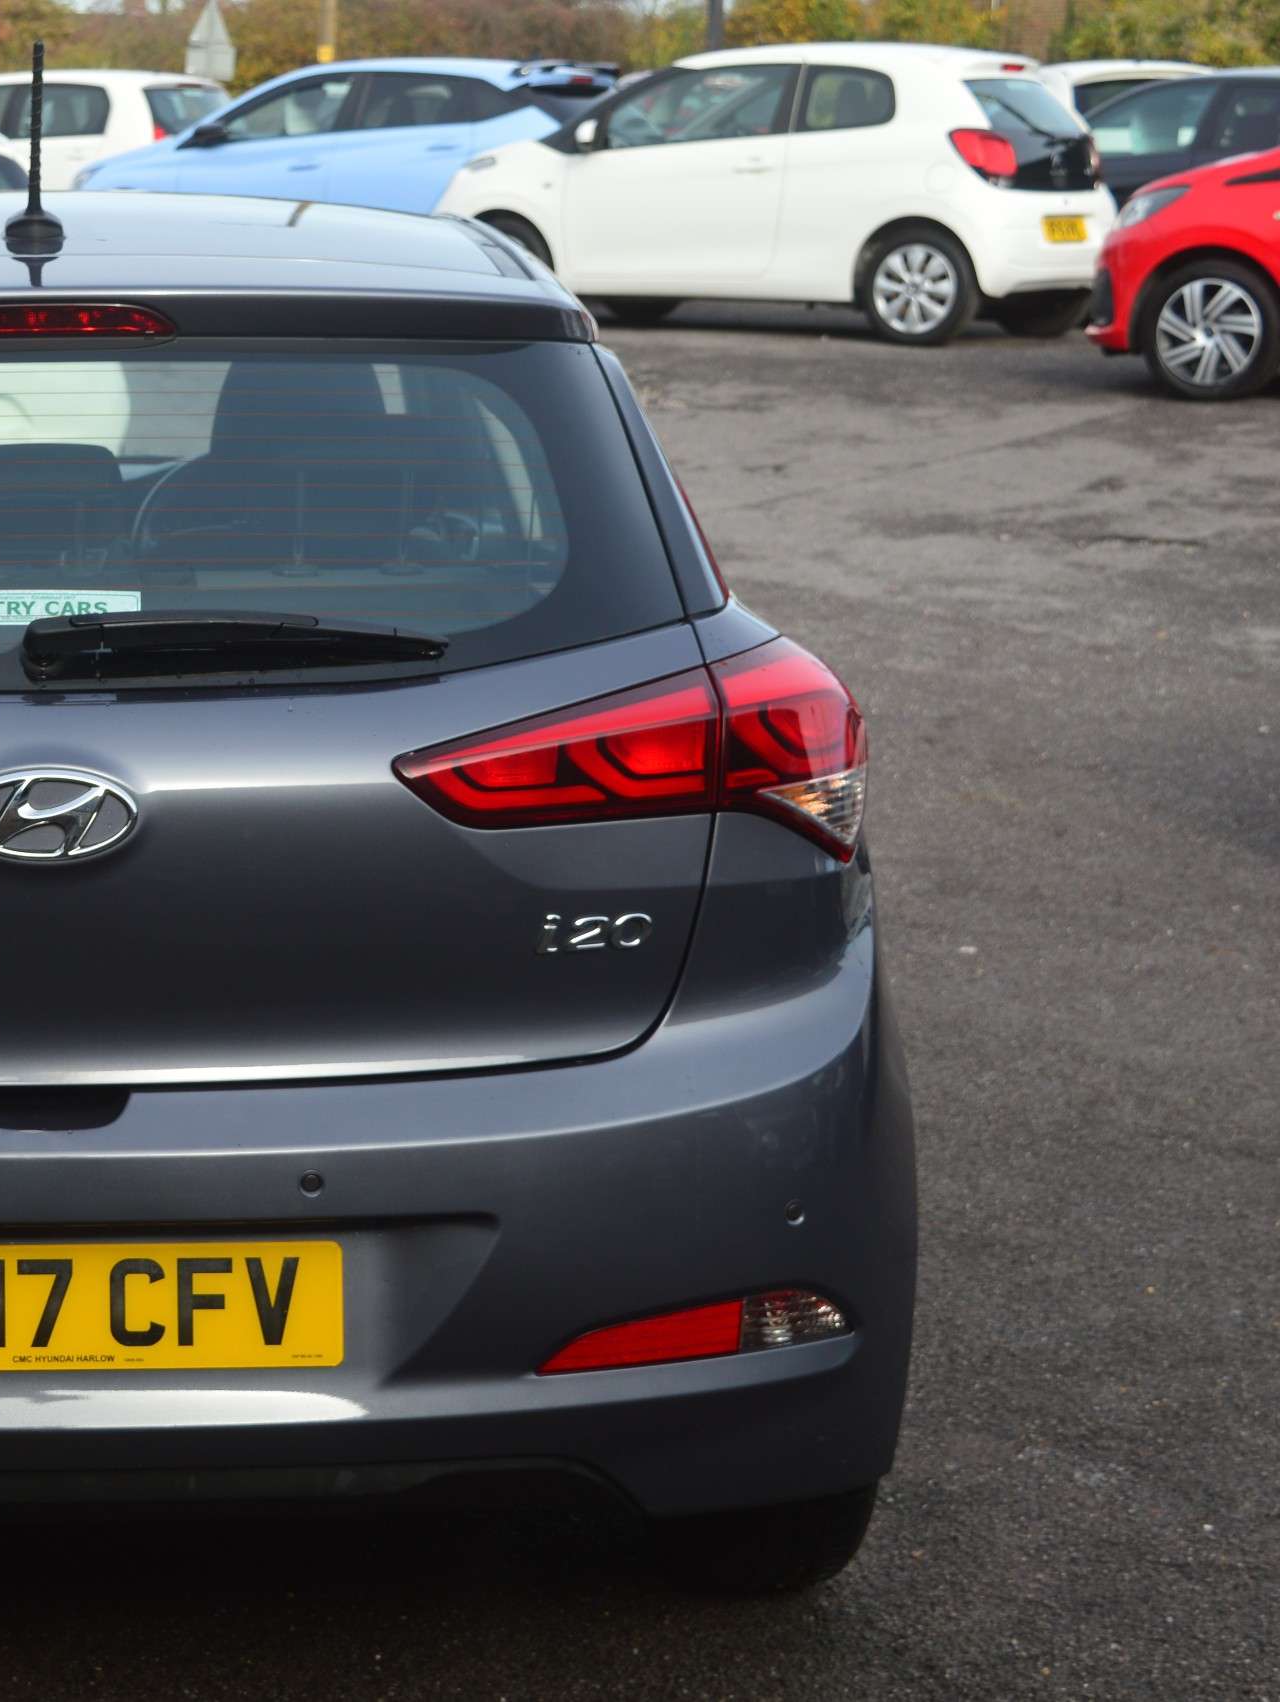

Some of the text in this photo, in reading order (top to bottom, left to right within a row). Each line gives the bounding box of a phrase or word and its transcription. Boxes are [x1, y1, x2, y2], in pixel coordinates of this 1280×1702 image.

[45, 601, 108, 616] CARS
[536, 913, 653, 955] i20
[109, 1257, 301, 1348] CFV
[12, 1354, 115, 1363] CMC HYUNDAI HARLOW
